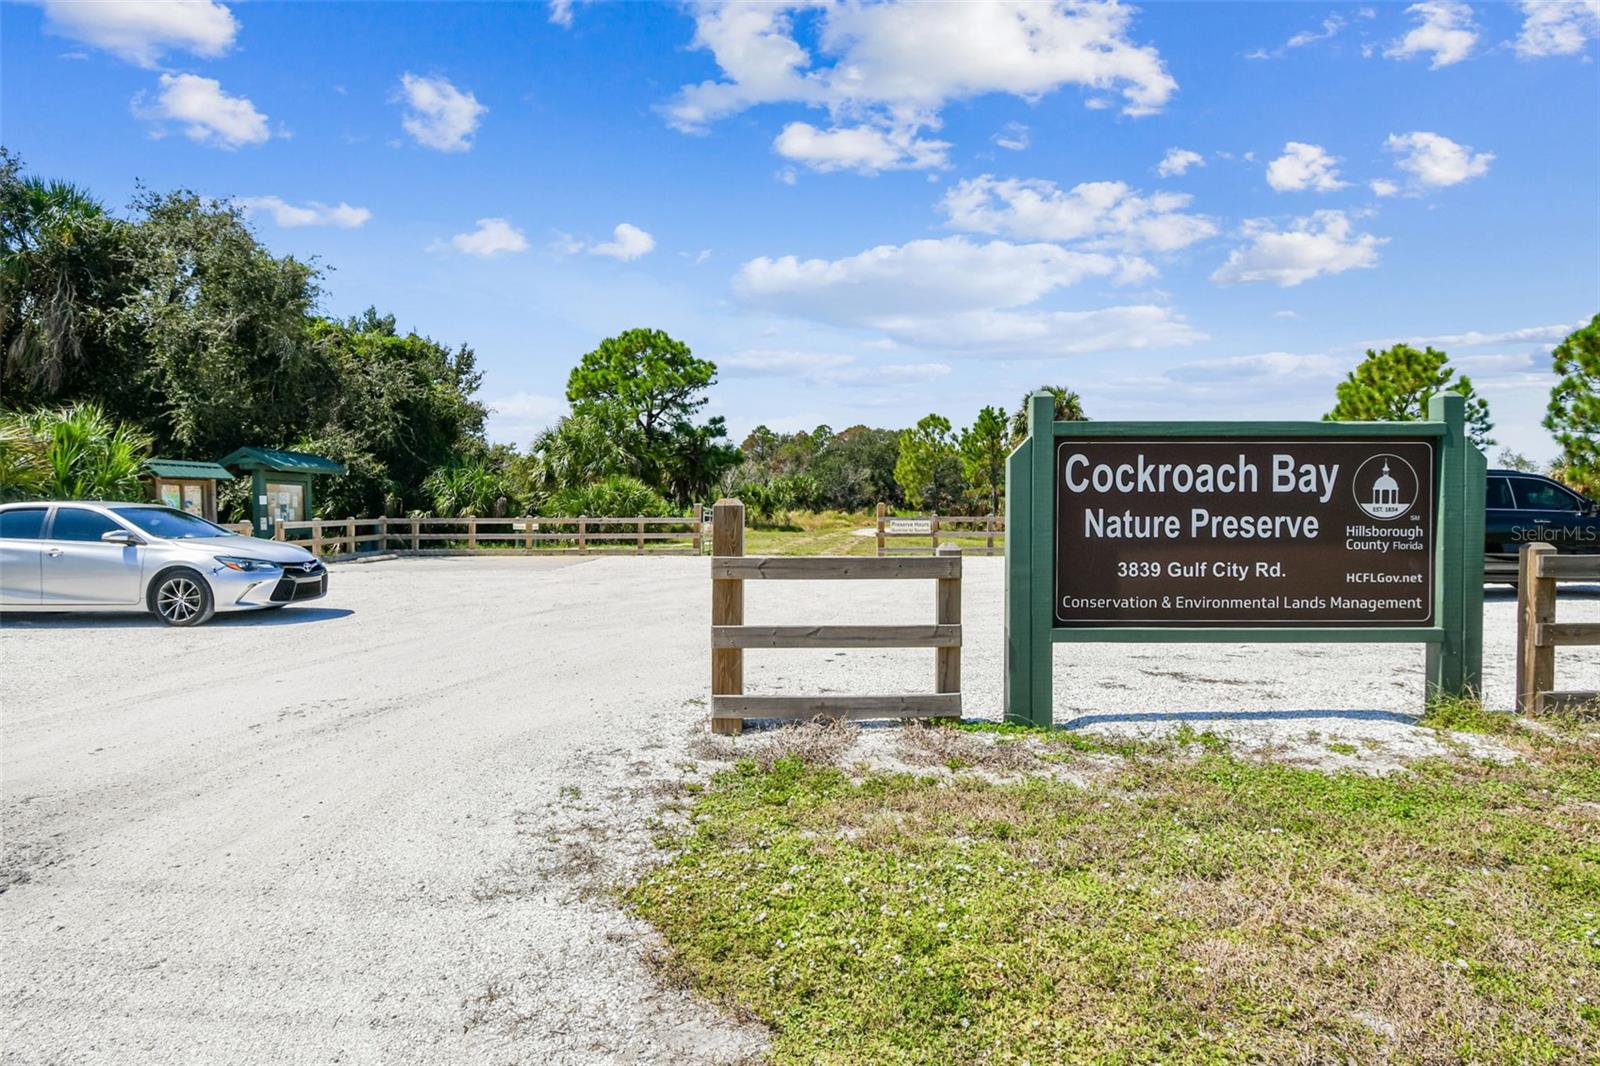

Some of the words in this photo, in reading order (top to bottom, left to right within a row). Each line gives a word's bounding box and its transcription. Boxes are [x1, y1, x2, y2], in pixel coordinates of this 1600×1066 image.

[1065, 454, 1258, 493] Cockroach
[1272, 454, 1340, 503] Bay
[1084, 508, 1181, 539] Nature
[1191, 508, 1319, 539] Preserve
[1346, 525, 1424, 540] Hillsborough
[1346, 538, 1390, 553] County
[1392, 541, 1424, 550] Florida
[1117, 561, 1162, 578] 3839
[1167, 561, 1208, 578] Gulf
[1212, 561, 1250, 581] City
[1255, 561, 1286, 578] Rd.
[1346, 572, 1423, 584] HCFLGov.net
[1062, 596, 1158, 609] Conservation
[1161, 596, 1172, 609] &
[1175, 596, 1280, 609] Environmental
[1283, 596, 1327, 609] Lands
[1330, 596, 1423, 612] Management
